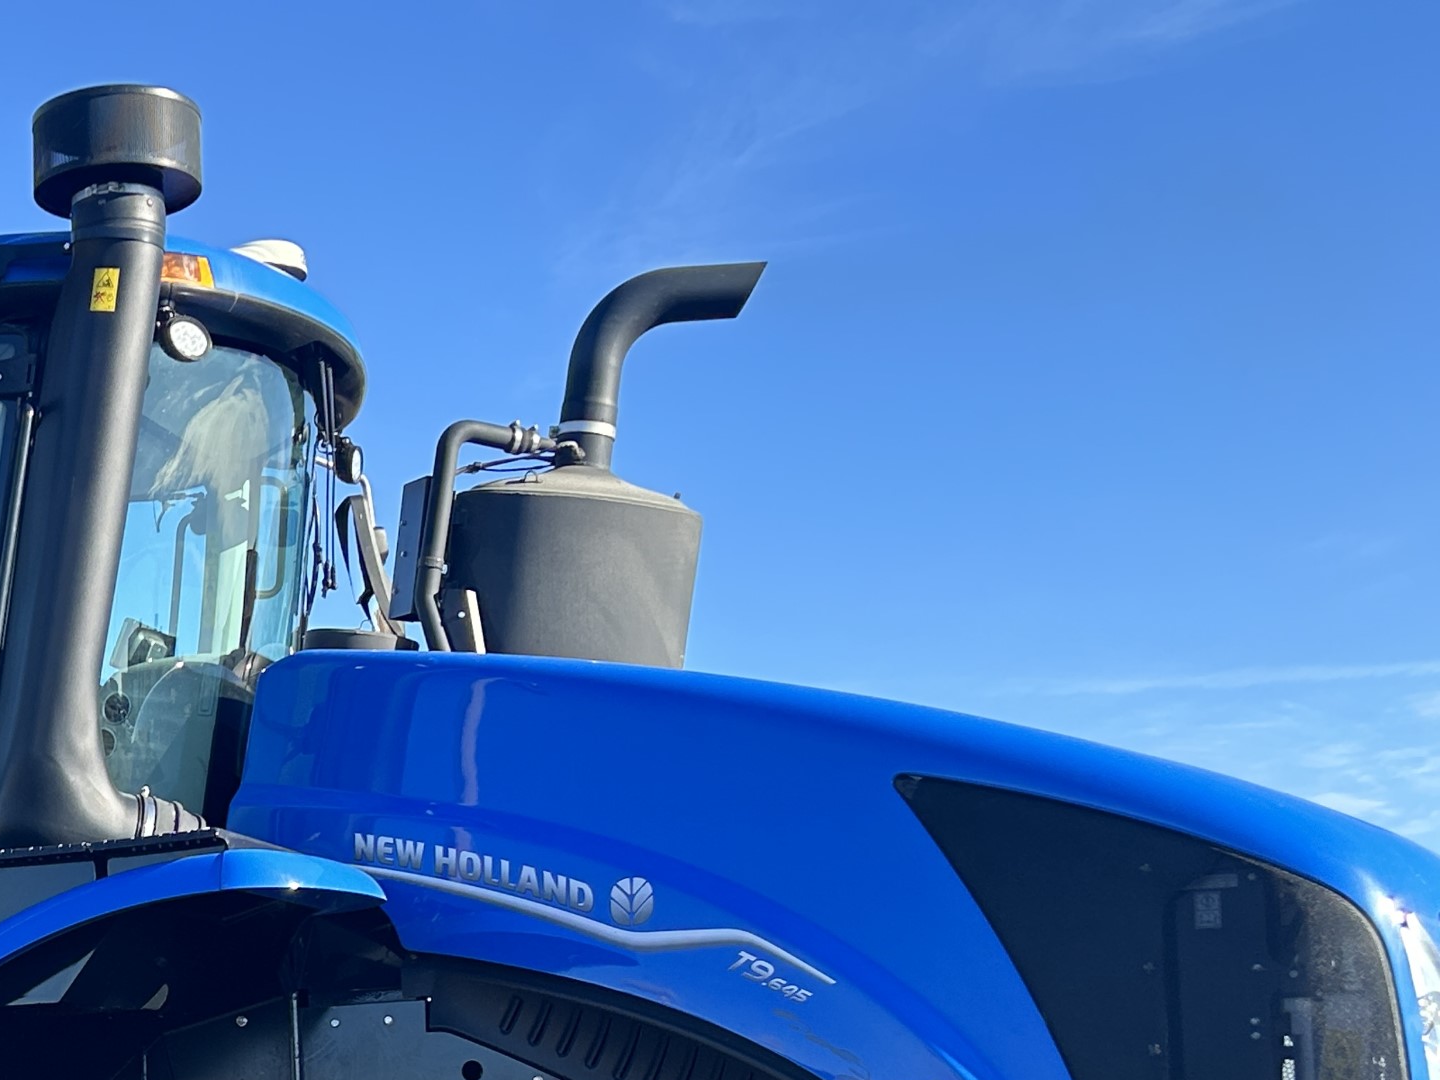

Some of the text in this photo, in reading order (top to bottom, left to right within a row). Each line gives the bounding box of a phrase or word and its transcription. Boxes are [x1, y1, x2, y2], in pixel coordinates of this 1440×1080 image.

[354, 833, 594, 912] NEW HOLLAND
[727, 951, 813, 1002] T9.645
